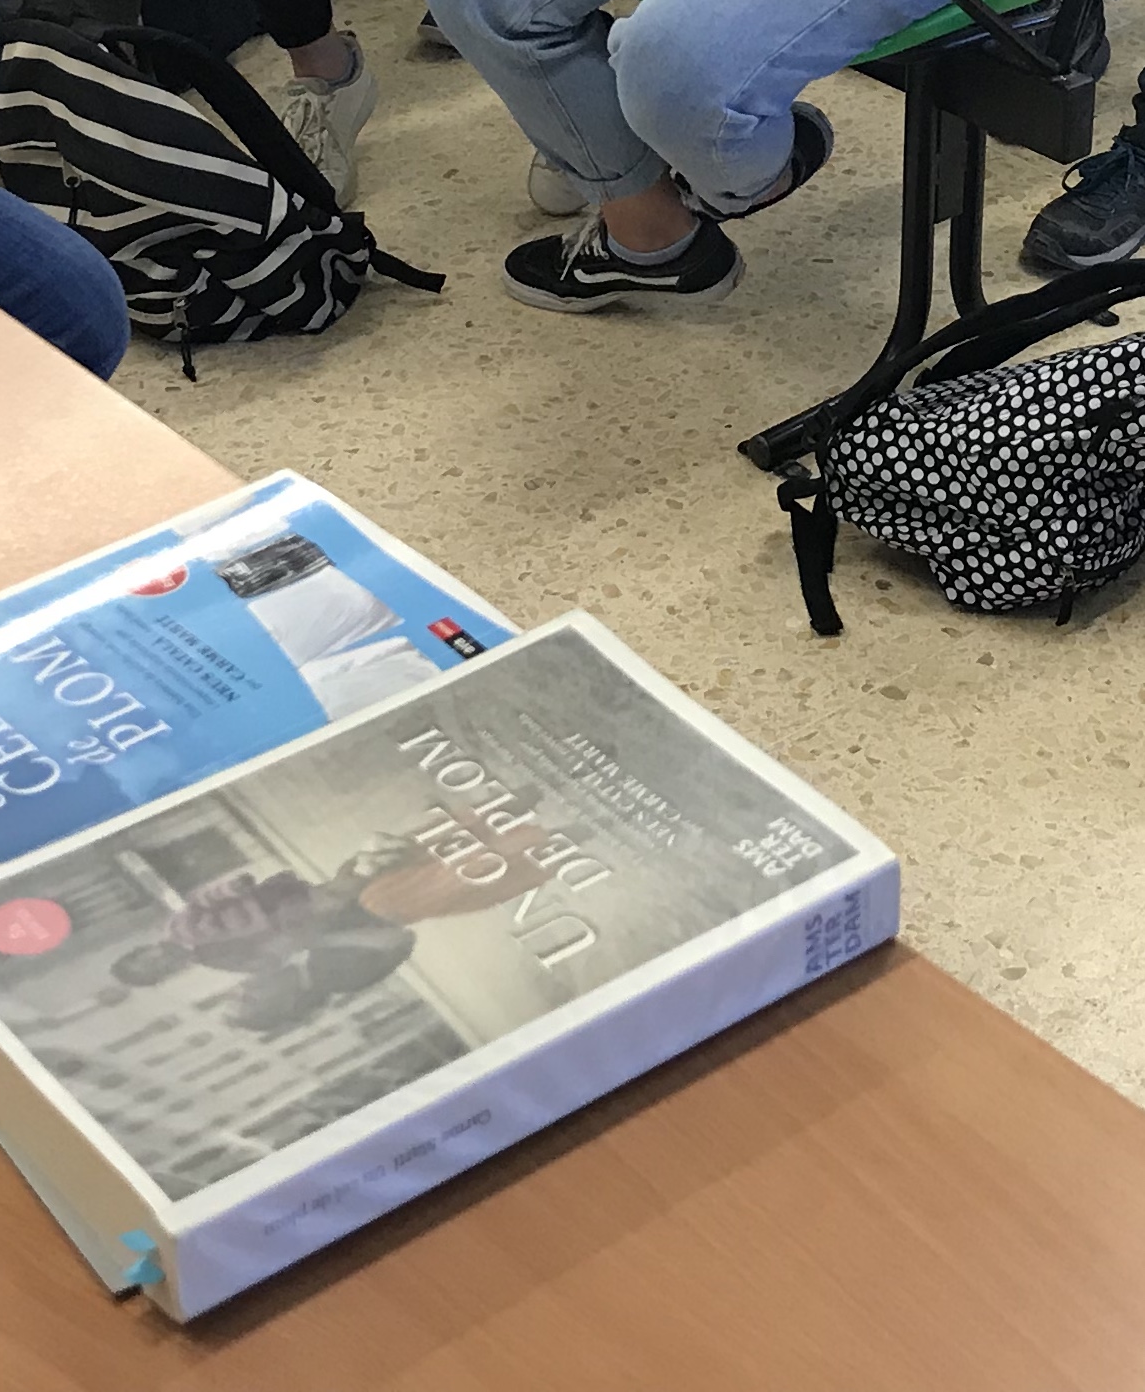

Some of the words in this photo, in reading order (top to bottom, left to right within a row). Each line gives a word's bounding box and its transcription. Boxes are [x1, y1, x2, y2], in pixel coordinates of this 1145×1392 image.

[10, 635, 174, 753] PLOM
[66, 734, 117, 765] de
[397, 725, 538, 837] PLOM
[412, 805, 509, 886] CEL
[523, 831, 614, 893] DE
[732, 838, 788, 878] AMS
[759, 833, 803, 870] TER
[767, 816, 824, 858] DAM
[509, 885, 598, 970] UN
[805, 913, 823, 974] AMS
[825, 911, 843, 968] TER
[844, 889, 862, 954] DAM
